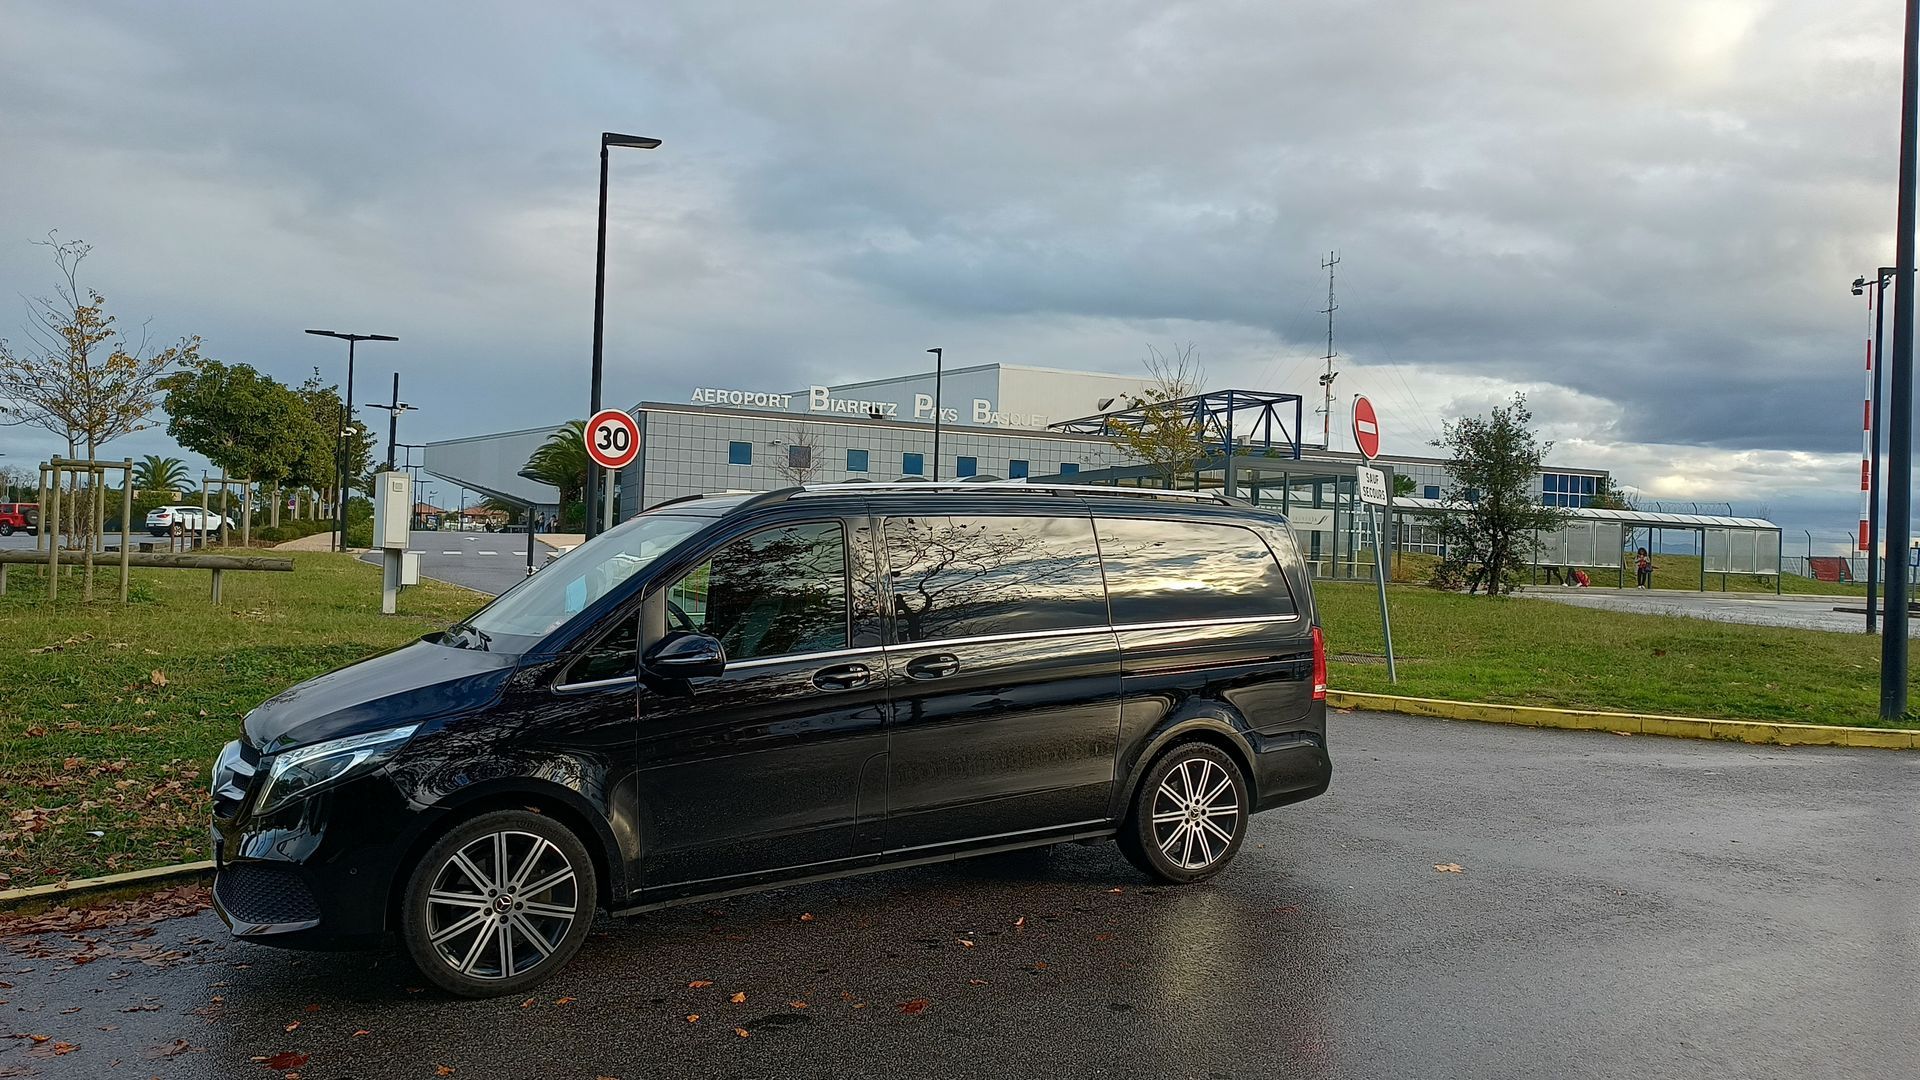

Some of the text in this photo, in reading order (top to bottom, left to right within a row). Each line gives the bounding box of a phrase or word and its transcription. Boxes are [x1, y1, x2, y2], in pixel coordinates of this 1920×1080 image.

[691, 387, 792, 409] AEROPORT
[809, 385, 898, 416] BIARRITZ
[597, 426, 630, 451] 30
[1366, 472, 1379, 485] SAUF
[1362, 486, 1386, 500] SECOURS
